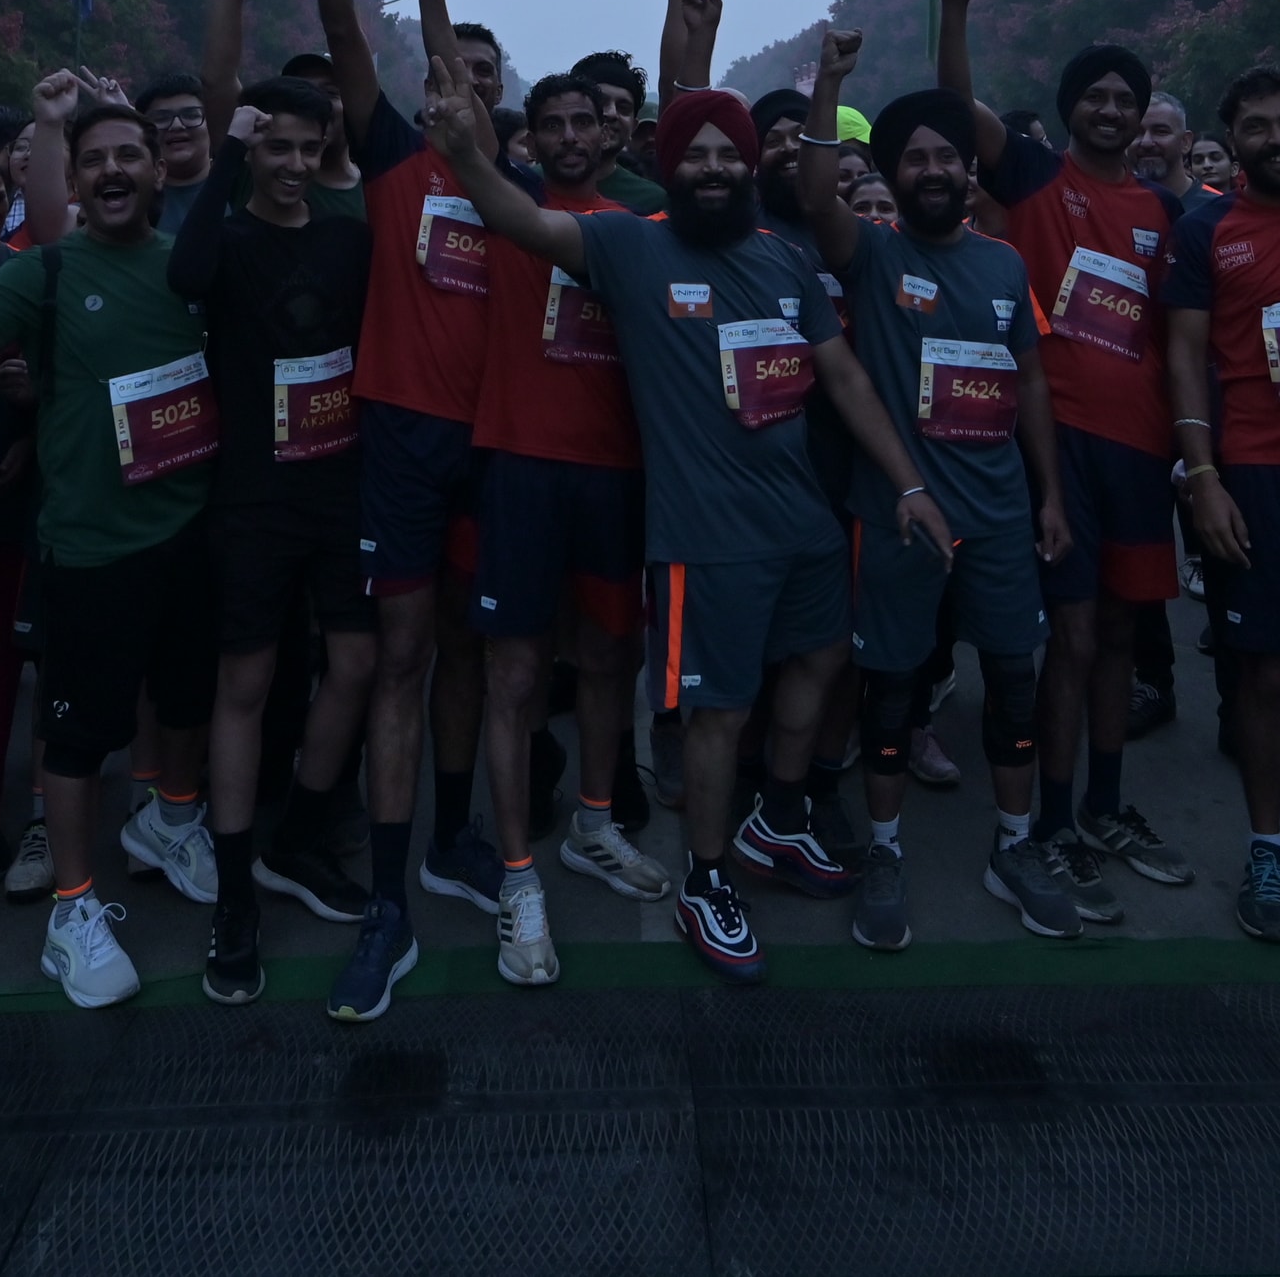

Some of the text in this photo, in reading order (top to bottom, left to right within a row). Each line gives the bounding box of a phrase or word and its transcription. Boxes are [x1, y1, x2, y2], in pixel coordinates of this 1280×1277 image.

[445, 231, 486, 256] 504
[443, 277, 456, 285] SUN
[457, 280, 474, 290] VIEW
[1088, 288, 1142, 321] 5406
[1078, 331, 1092, 340] SUN
[1093, 336, 1111, 347] VIEW
[756, 357, 800, 380] 5428
[952, 379, 1001, 399] 5424
[310, 387, 349, 414] 5395
[152, 396, 201, 430] 5025
[300, 409, 351, 429] AKSHAT
[157, 460, 171, 469] SUN
[172, 452, 191, 464] VIEW
